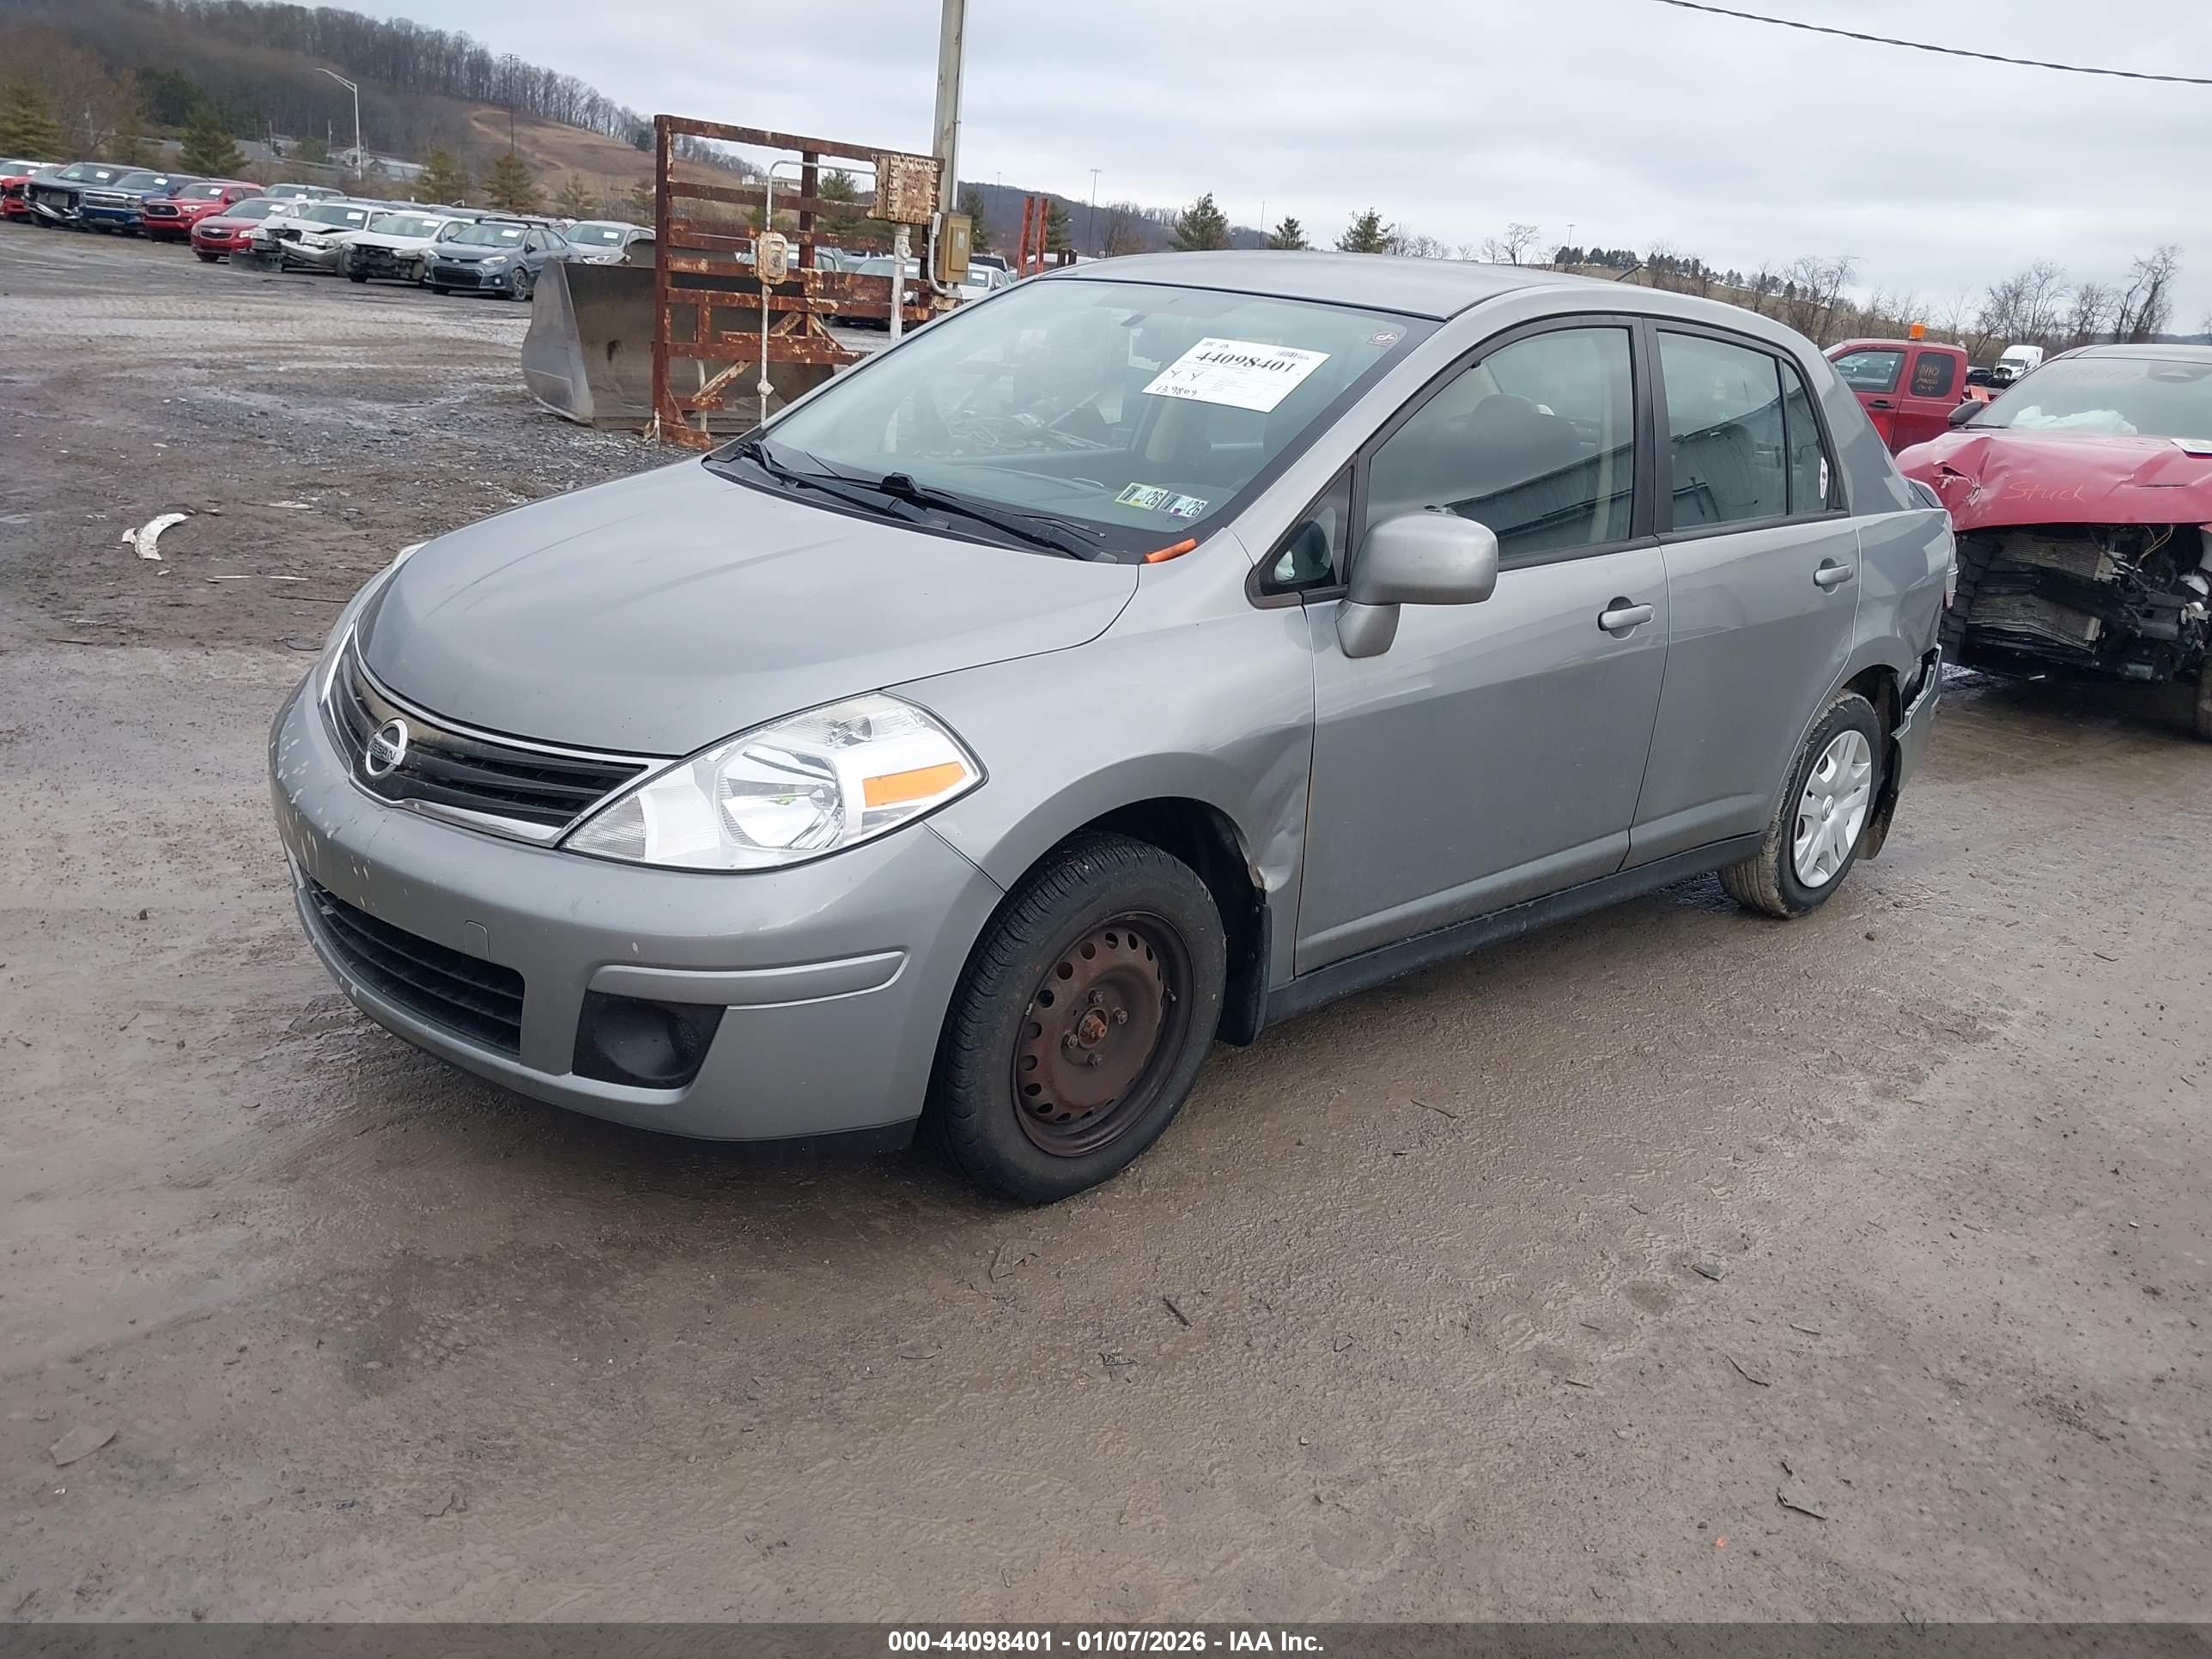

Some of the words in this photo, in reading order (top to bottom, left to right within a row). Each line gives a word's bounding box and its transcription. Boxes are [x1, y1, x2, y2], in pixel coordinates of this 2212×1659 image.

[1195, 351, 1296, 373] 44098401
[1145, 491, 1164, 506] 26
[2002, 481, 2089, 503] Stuck
[1187, 501, 1205, 516] 26
[369, 742, 397, 761] SSAN
